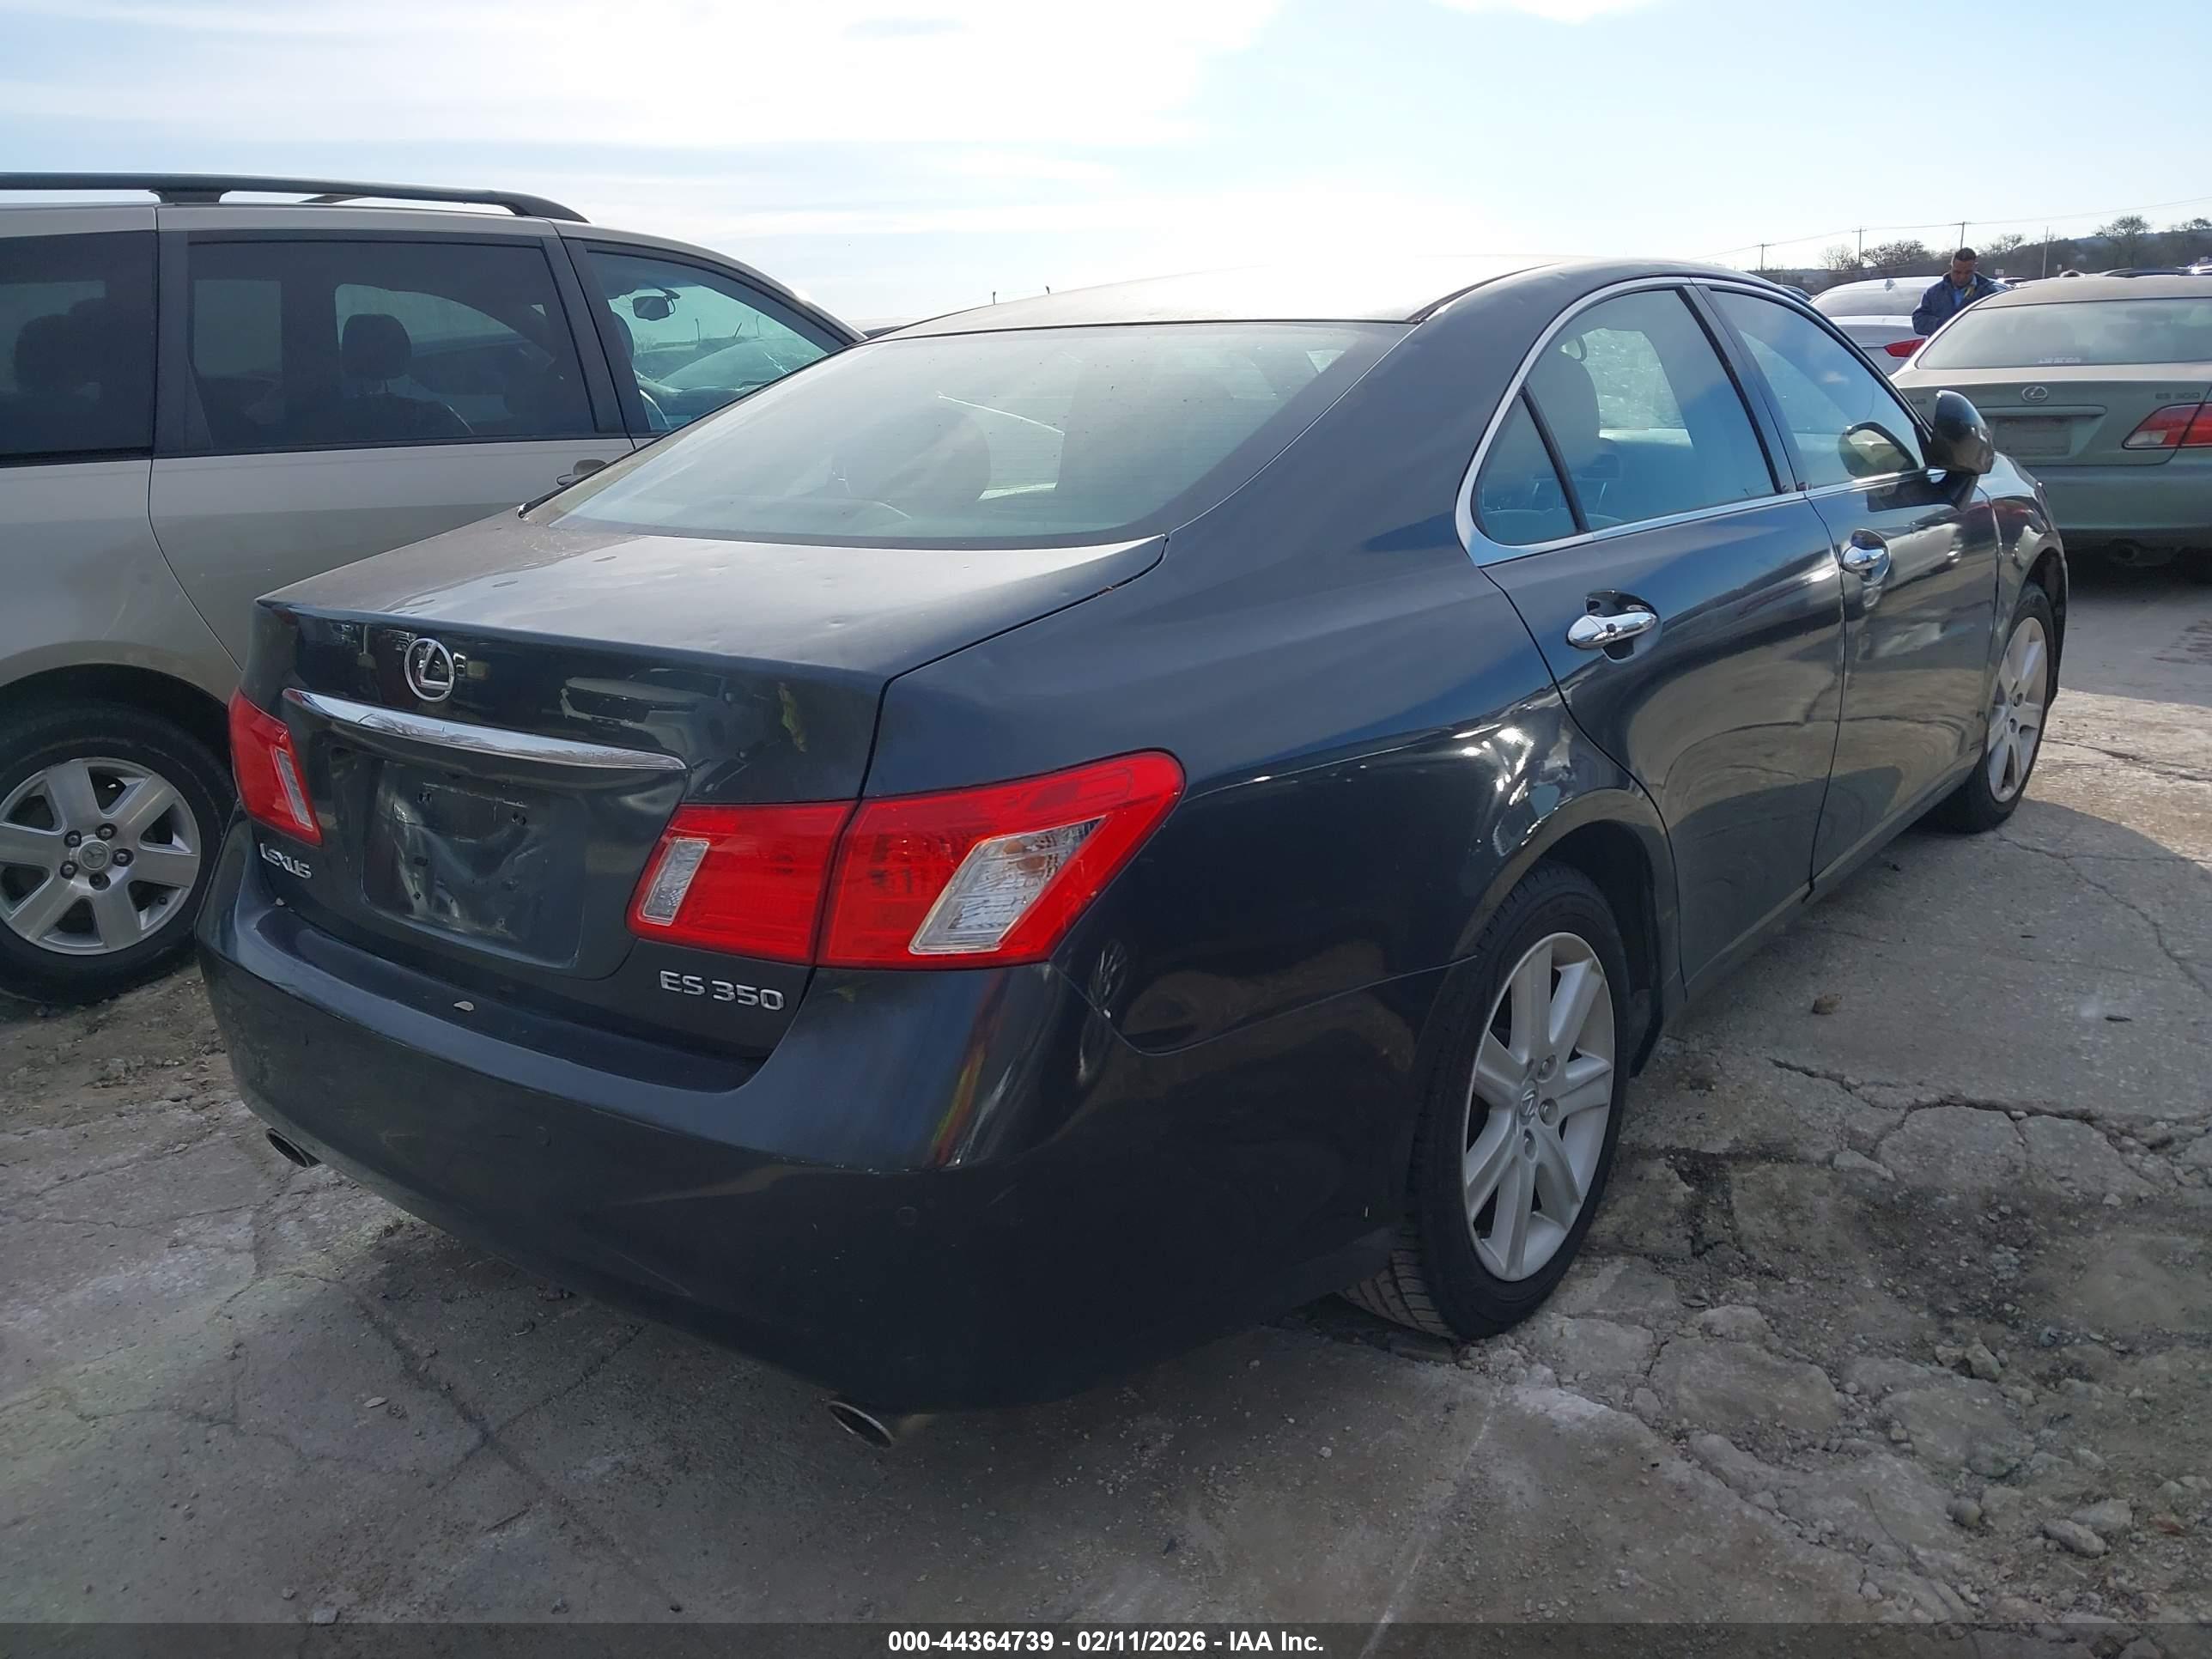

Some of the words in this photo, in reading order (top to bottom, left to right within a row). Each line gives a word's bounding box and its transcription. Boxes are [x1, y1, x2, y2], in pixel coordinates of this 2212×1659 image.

[259, 842, 312, 879] LEXUS
[659, 970, 705, 995] ES
[711, 980, 784, 1011] 350
